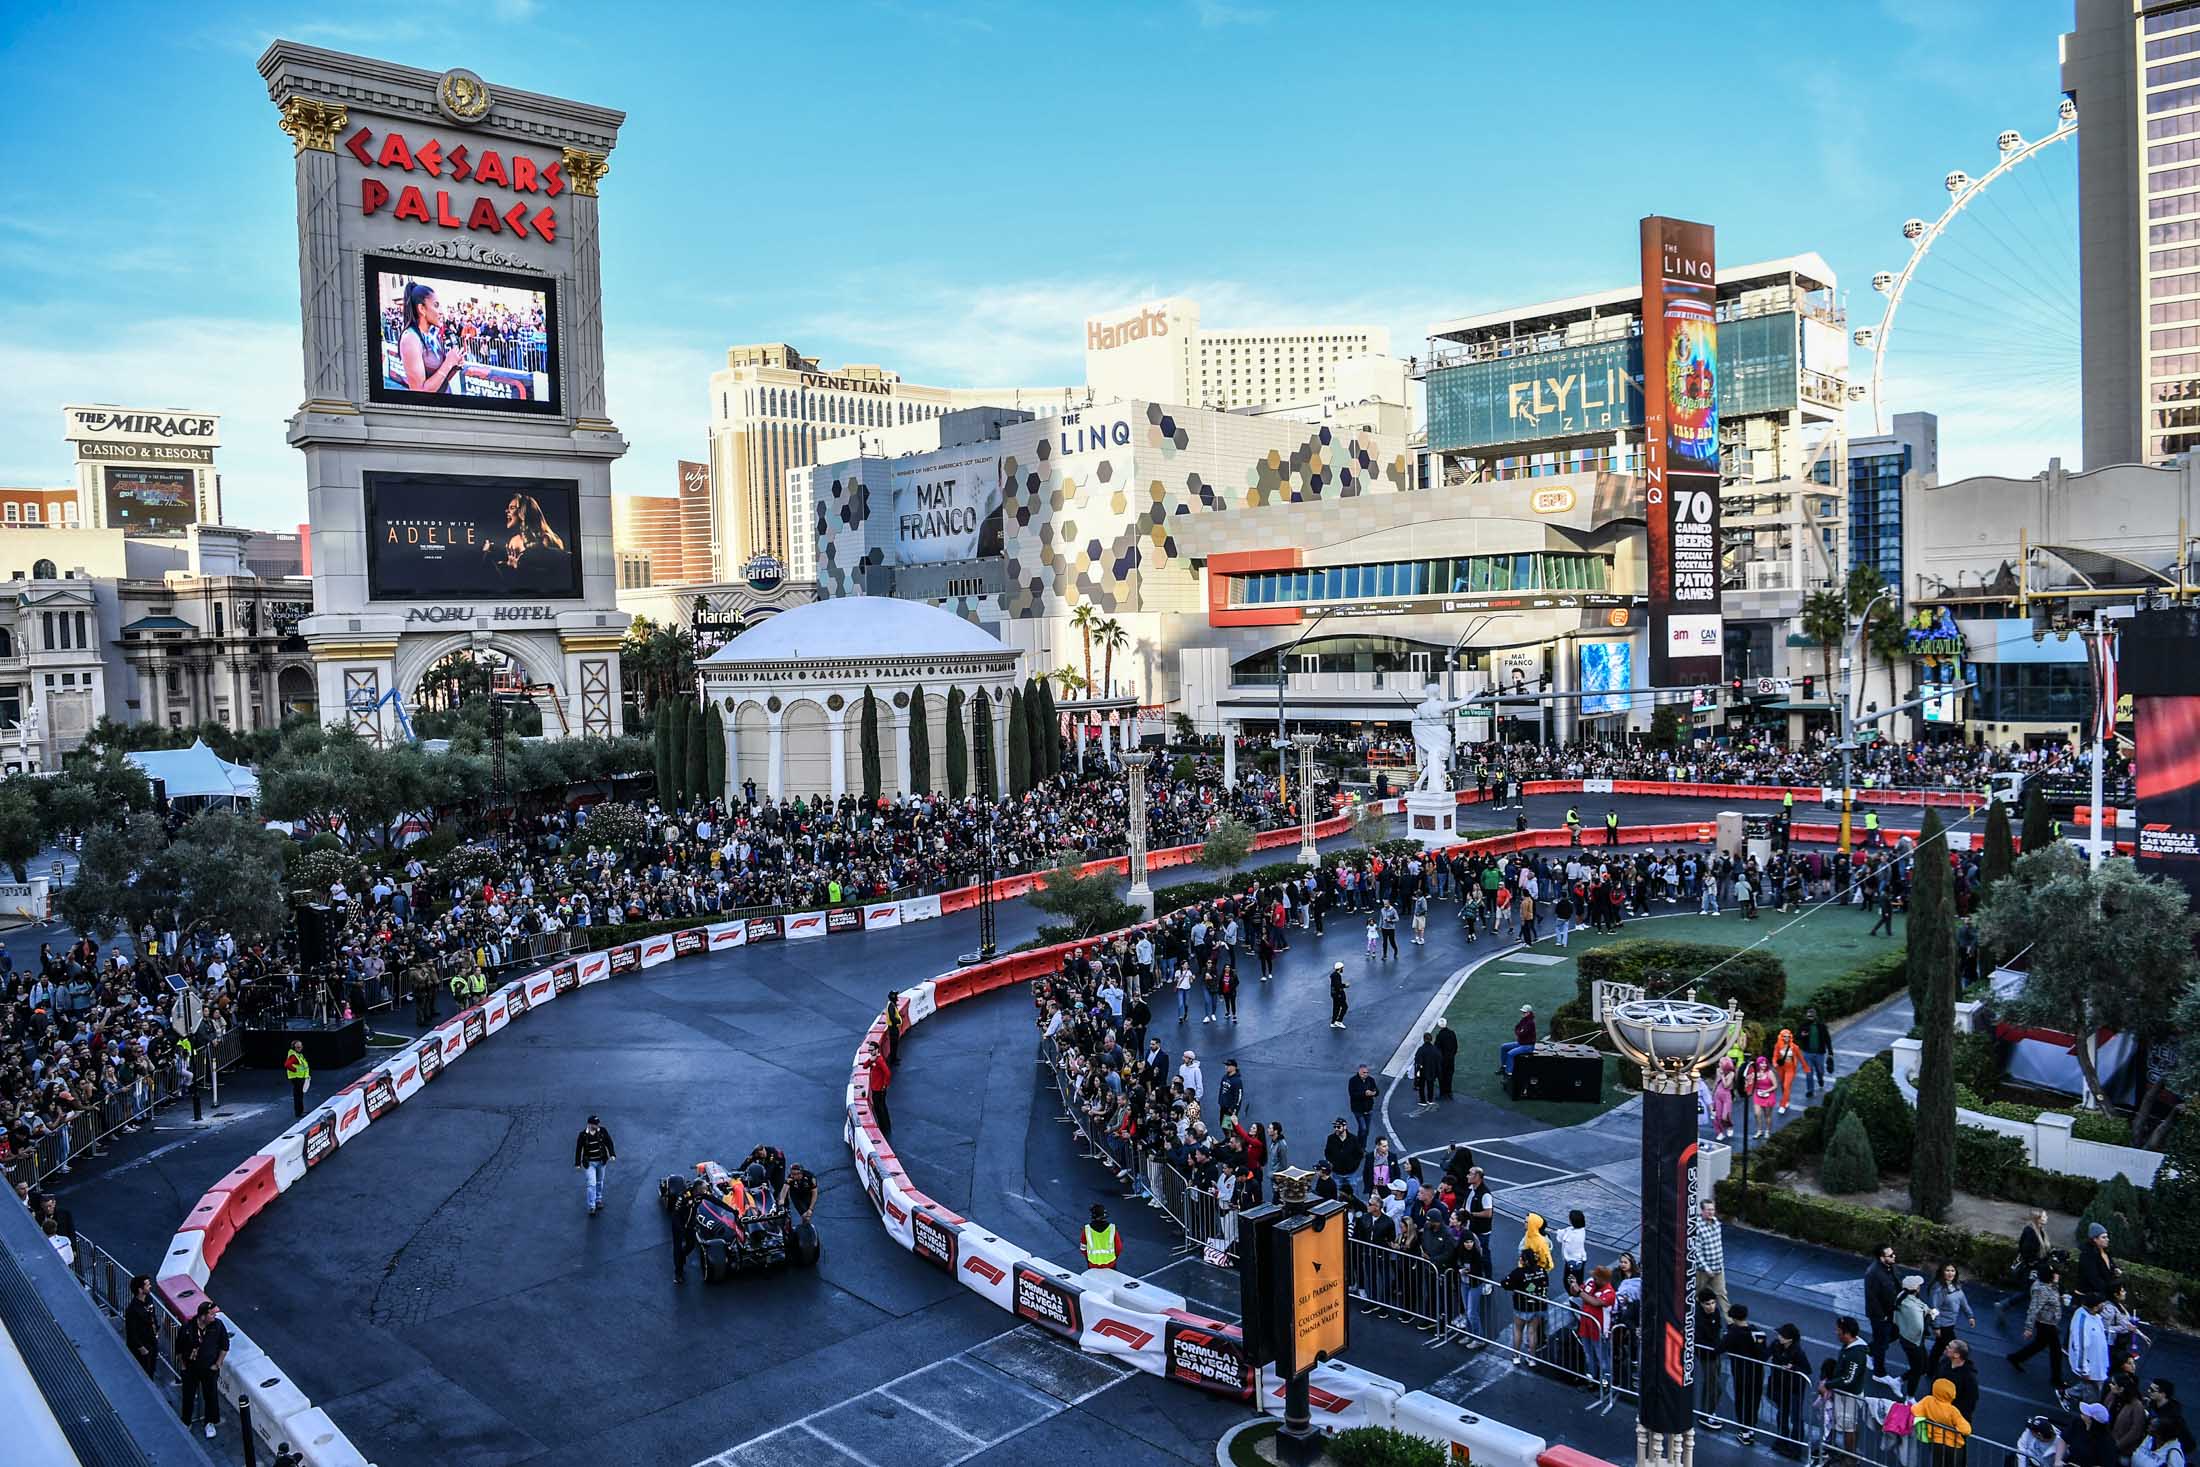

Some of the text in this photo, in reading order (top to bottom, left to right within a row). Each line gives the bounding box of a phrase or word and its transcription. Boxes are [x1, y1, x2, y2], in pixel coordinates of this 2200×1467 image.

[345, 127, 566, 197] CAESARS
[362, 178, 558, 243] PALACE
[1664, 244, 1678, 254] THE
[1664, 256, 1712, 278] LINQ
[1088, 308, 1168, 350] Harrah's
[1508, 344, 1626, 369] CAESARS ENTERT
[1508, 367, 1638, 418] FLYLIN
[75, 412, 214, 437] THE MIRAGE
[1061, 414, 1080, 426] THE
[1563, 410, 1630, 430] ZIPL
[1062, 420, 1130, 456] LINQ
[82, 444, 211, 460] CASINO & RESORT
[1647, 427, 1663, 505] LINQ
[917, 480, 956, 511] MAT
[1674, 491, 1712, 524] 70
[388, 527, 475, 545] ADELE
[900, 506, 977, 542] FRANCO
[1676, 524, 1712, 534] CANNED
[1674, 534, 1713, 548] BEERS
[1675, 551, 1713, 560] SPECIALTY
[1675, 560, 1714, 570] COCKTAILS
[1675, 573, 1714, 588] PATIO
[1676, 587, 1714, 600] GAMES
[406, 606, 556, 622] NOBU HOTEL
[698, 608, 745, 624] Harrah's
[1700, 628, 1716, 640] CAN
[754, 672, 793, 681] PALACE
[812, 667, 868, 680] CAESARS
[876, 666, 922, 678] PALACE
[940, 662, 982, 674] CAESARS
[2140, 831, 2196, 840] FORMULA 1
[2140, 838, 2195, 848] LAS VEGAS
[2140, 844, 2200, 855] GRAND PRIX
[1687, 1166, 1698, 1237] VEGAS
[916, 1219, 942, 1241] FORMULA
[916, 1230, 947, 1252] LAS VEGAS
[917, 1236, 949, 1263] GRAND PRIX
[1686, 1237, 1697, 1276] LAS
[1019, 1278, 1056, 1304] FORMULA
[1019, 1287, 1035, 1300] LAS
[1036, 1294, 1064, 1314] VEGAS
[1298, 1280, 1338, 1306] SELF PARKING
[1019, 1296, 1048, 1315] GRAND
[1048, 1308, 1069, 1324] PRIX
[1298, 1298, 1340, 1328] COLOSSEUM &
[1299, 1310, 1339, 1338] OMNIA VALET
[1174, 1339, 1231, 1363] FORMULA
[1683, 1292, 1697, 1388] FORMULA
[1174, 1349, 1198, 1362] LAS
[1198, 1356, 1239, 1376] VEGAS
[1176, 1358, 1215, 1380] GRAND
[1215, 1371, 1242, 1388] PRIX
